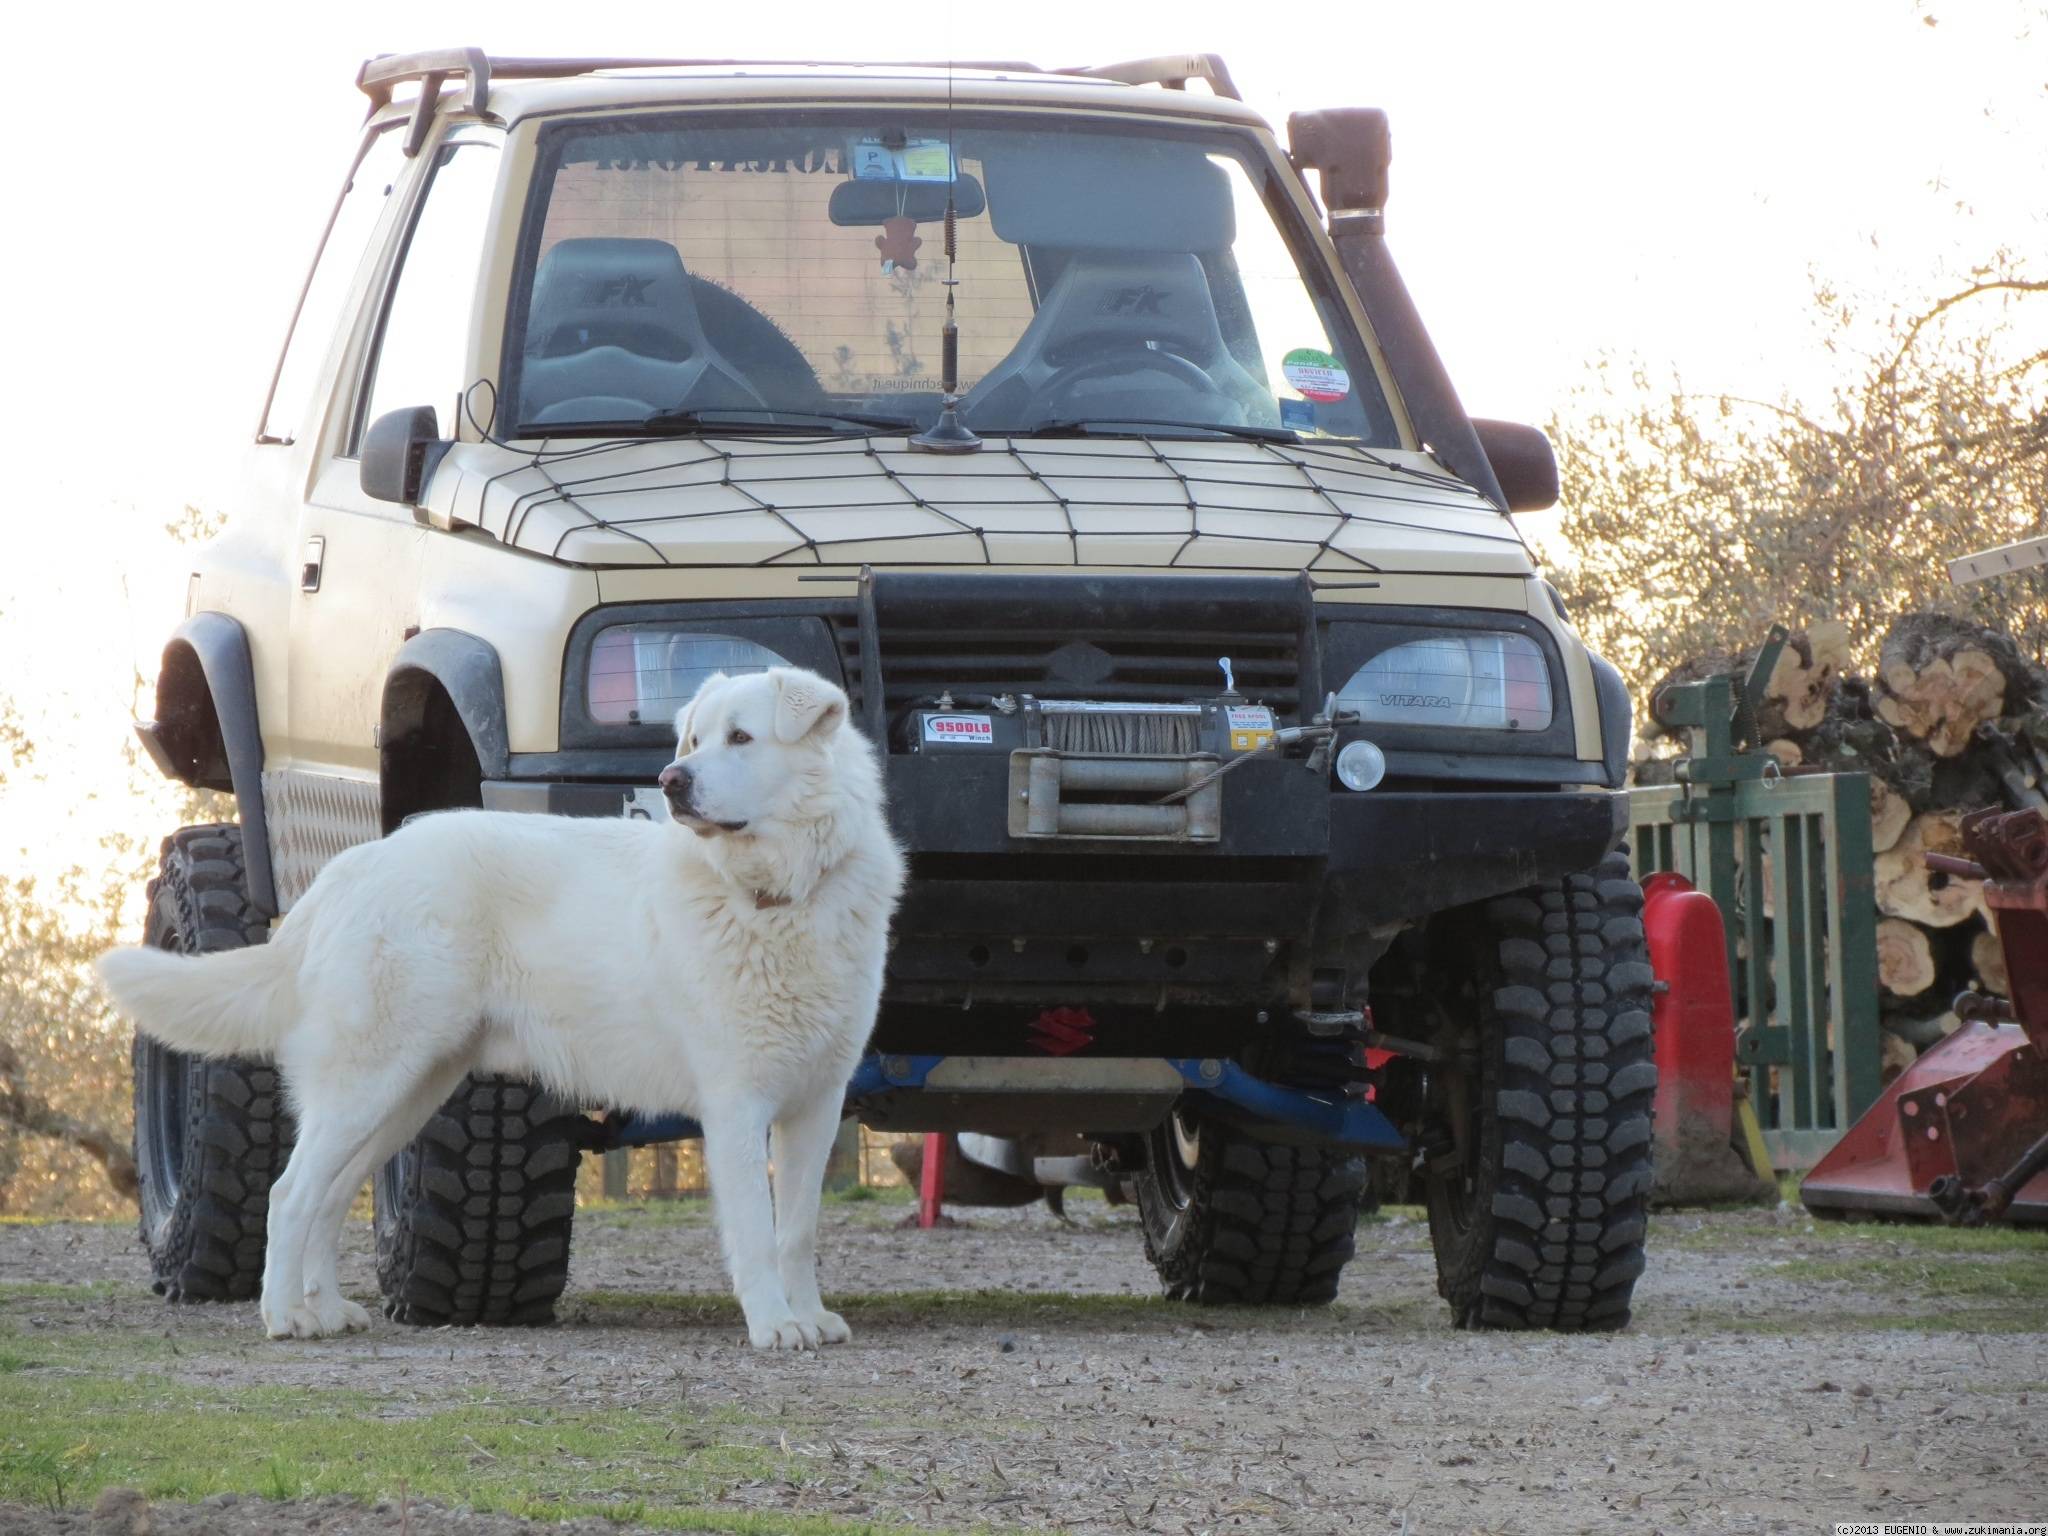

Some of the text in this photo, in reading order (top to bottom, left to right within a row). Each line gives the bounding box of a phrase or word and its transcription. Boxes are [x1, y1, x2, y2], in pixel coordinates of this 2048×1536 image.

[867, 151, 878, 161] P
[1379, 694, 1451, 708] VITARA
[935, 721, 990, 733] 9500LB
